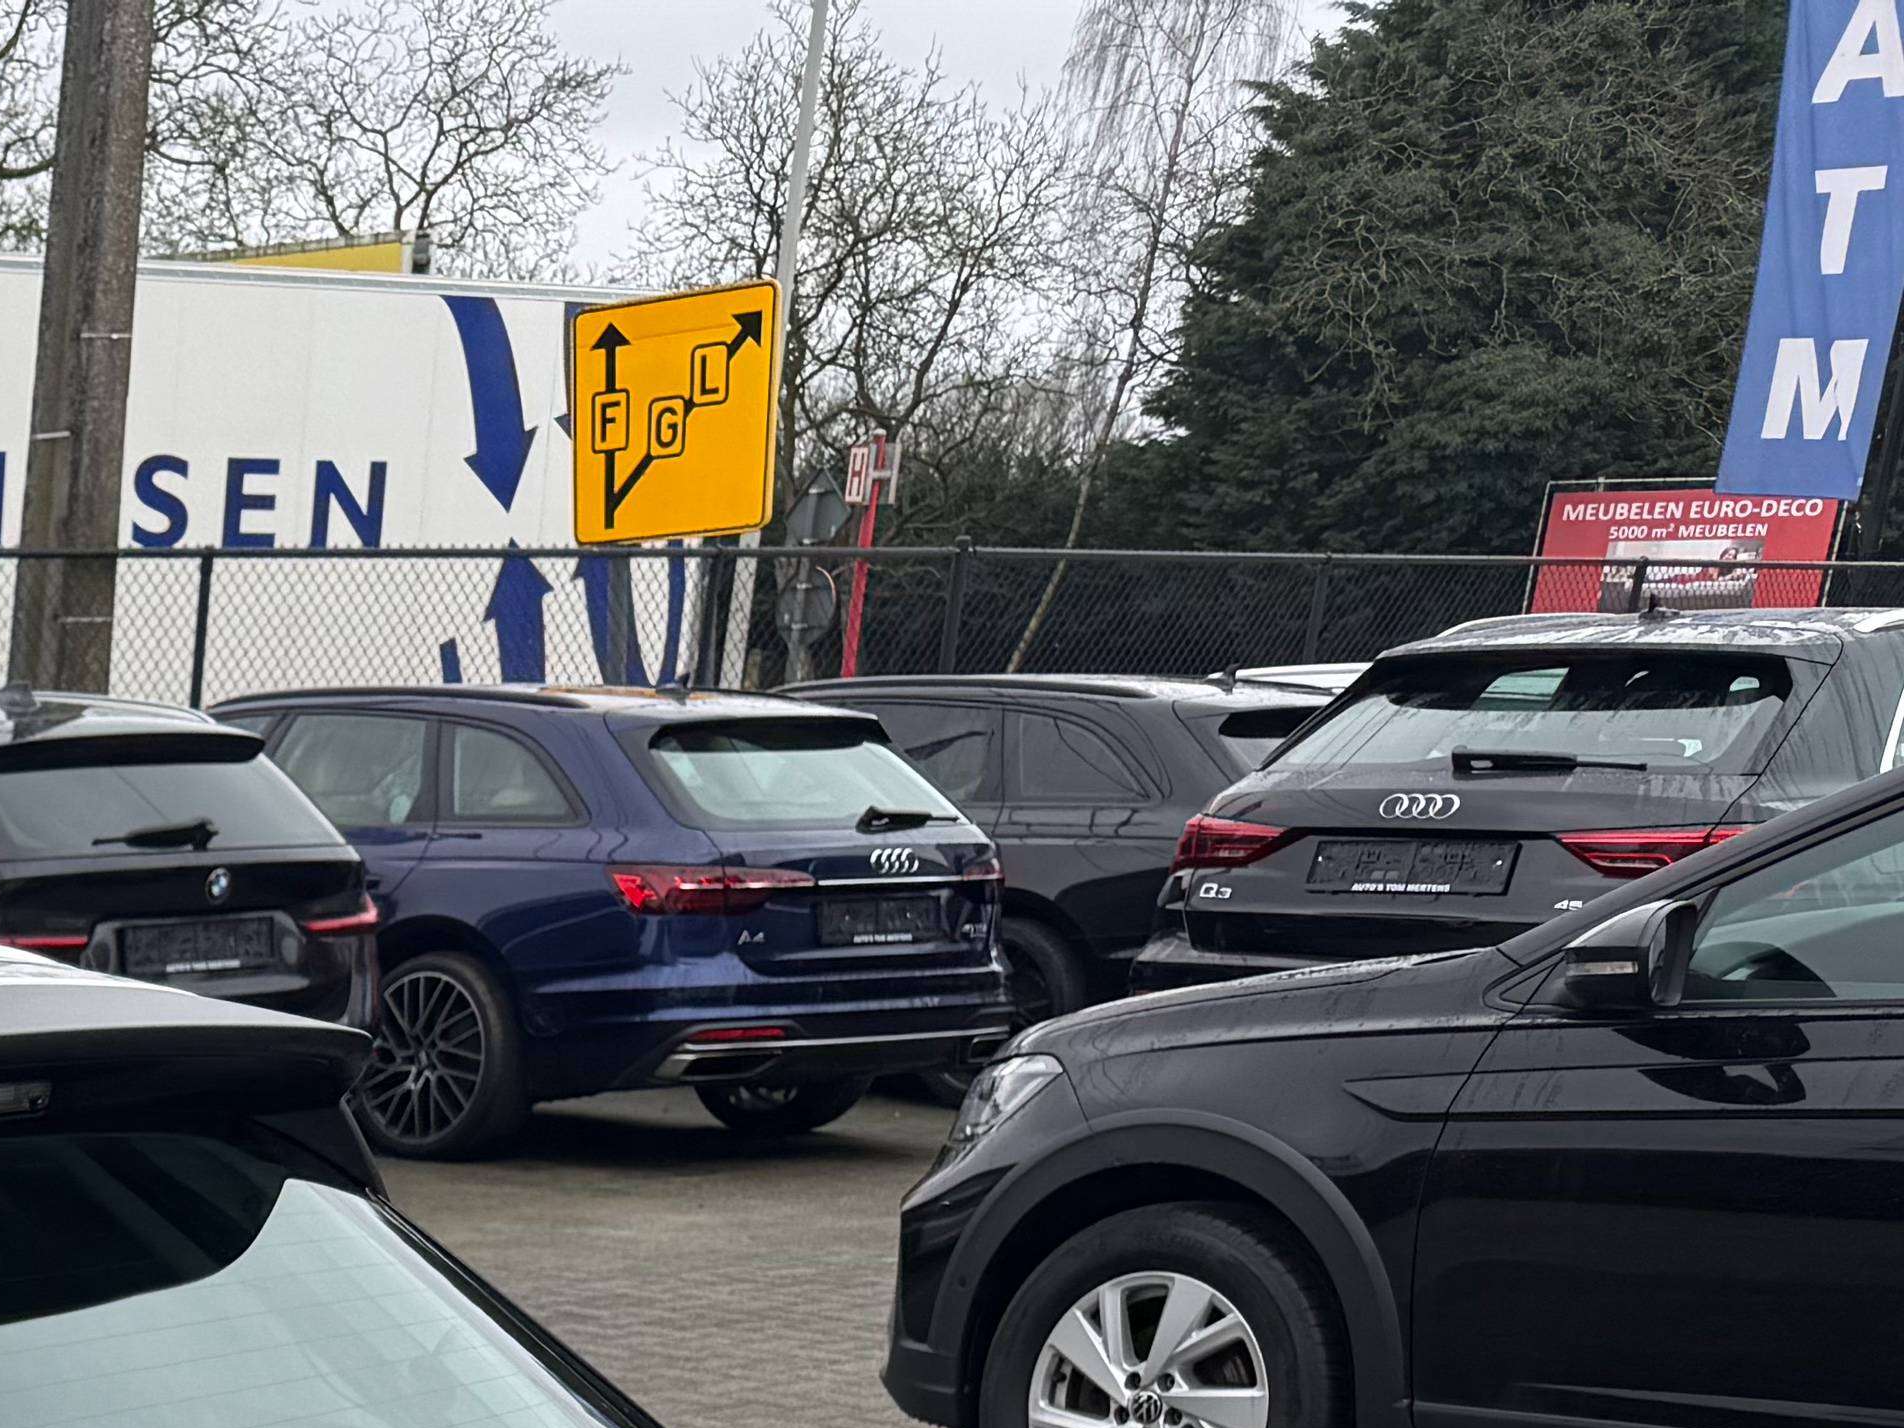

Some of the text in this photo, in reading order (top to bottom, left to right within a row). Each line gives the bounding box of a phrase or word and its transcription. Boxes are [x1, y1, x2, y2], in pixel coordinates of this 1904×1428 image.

[700, 355, 718, 396] L
[601, 401, 621, 442] F
[656, 406, 678, 448] G
[1562, 498, 1824, 521] MEUBELEN EURO-DECO
[1608, 525, 1647, 539] 5000
[1678, 523, 1768, 538] MEUBELEN
[1199, 883, 1232, 899] Q3
